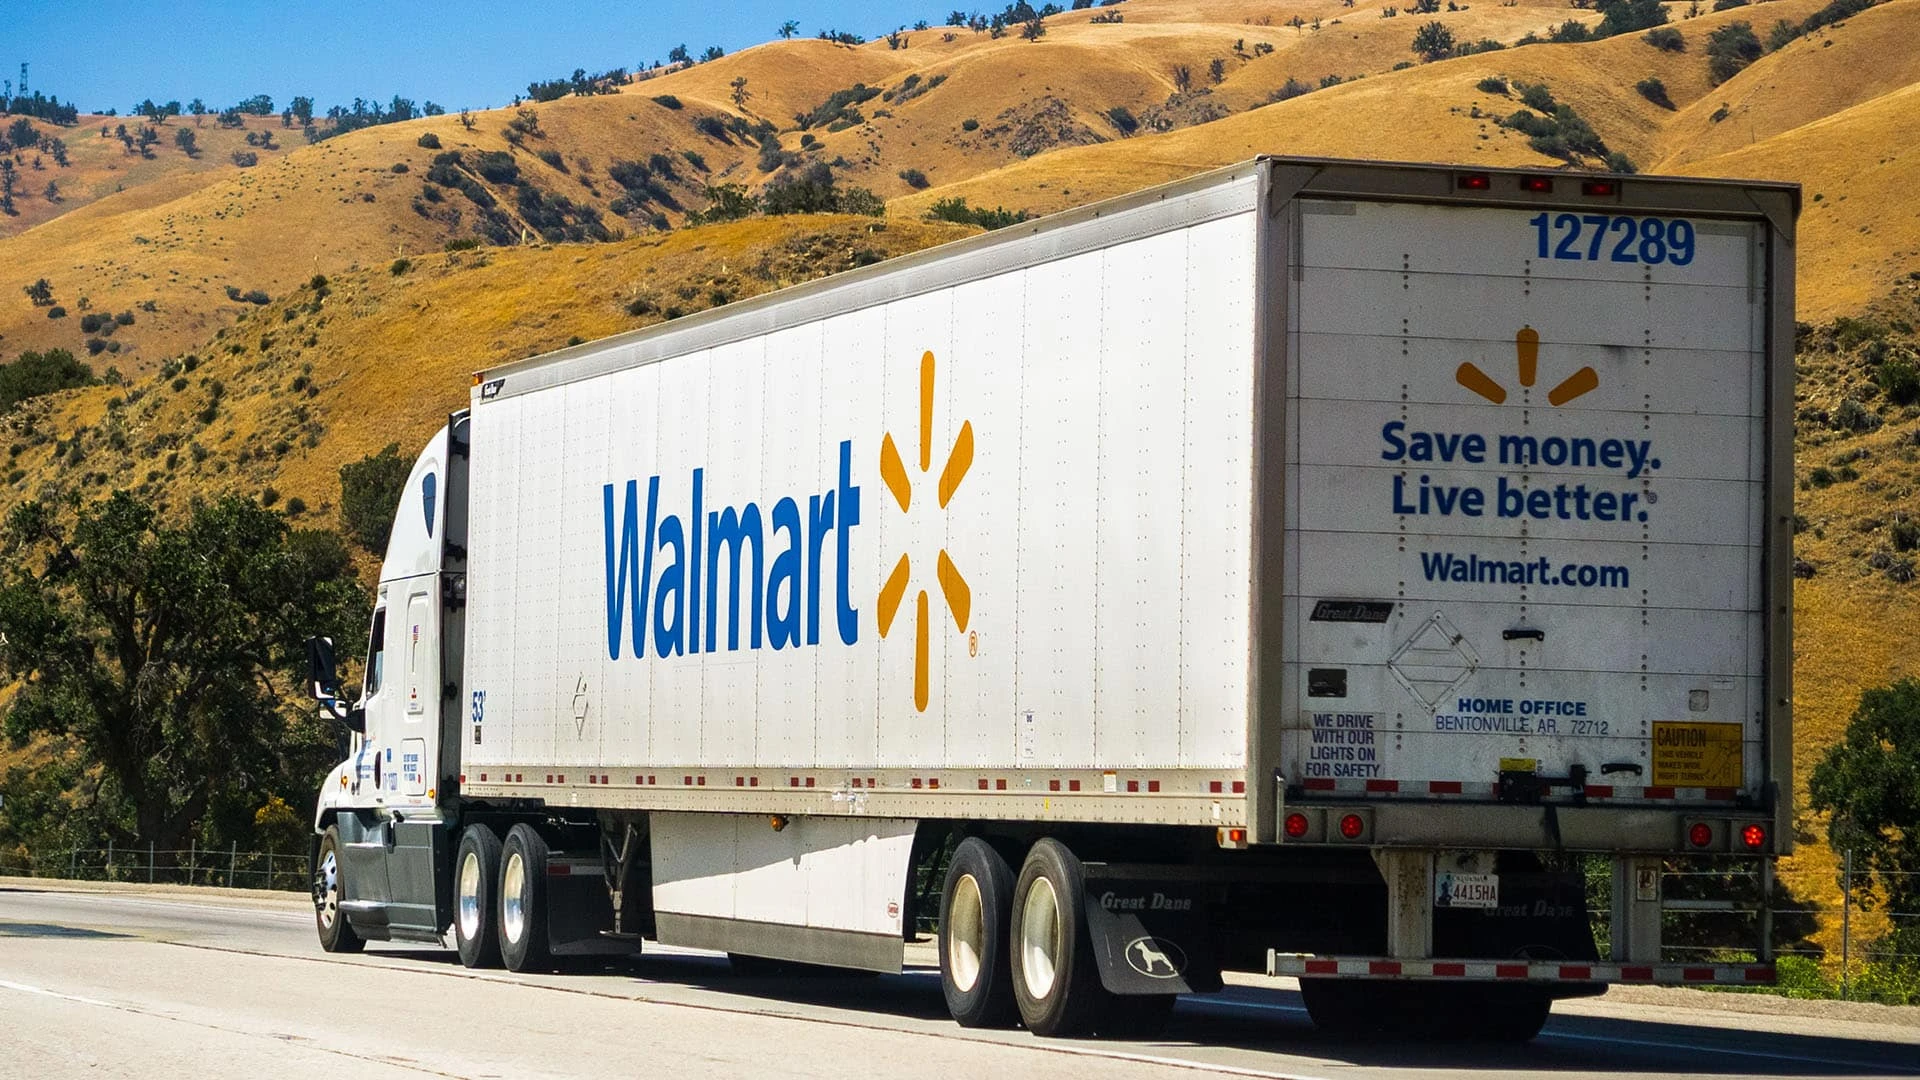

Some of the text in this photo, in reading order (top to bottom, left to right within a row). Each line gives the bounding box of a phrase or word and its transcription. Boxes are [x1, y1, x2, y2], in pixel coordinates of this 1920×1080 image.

[1530, 213, 1695, 266] 127289
[1381, 422, 1661, 479] Save money.
[1392, 476, 1648, 522] Live better.
[603, 439, 861, 661] Walmart
[1421, 552, 1629, 588] Walmart.com
[1458, 698, 1587, 716] HOME OFFICE
[1313, 713, 1374, 728] WE DRIVE
[1435, 715, 1609, 735] BENTONVILLE, AR. 72712
[1312, 729, 1374, 744] WITH OUR
[1657, 728, 1706, 747] CAUTION
[1310, 746, 1375, 761] LIGHTS ON
[1306, 762, 1380, 777] FOR SAFETY
[1101, 891, 1191, 910] Great Dane
[1453, 884, 1496, 901] 4415HA
